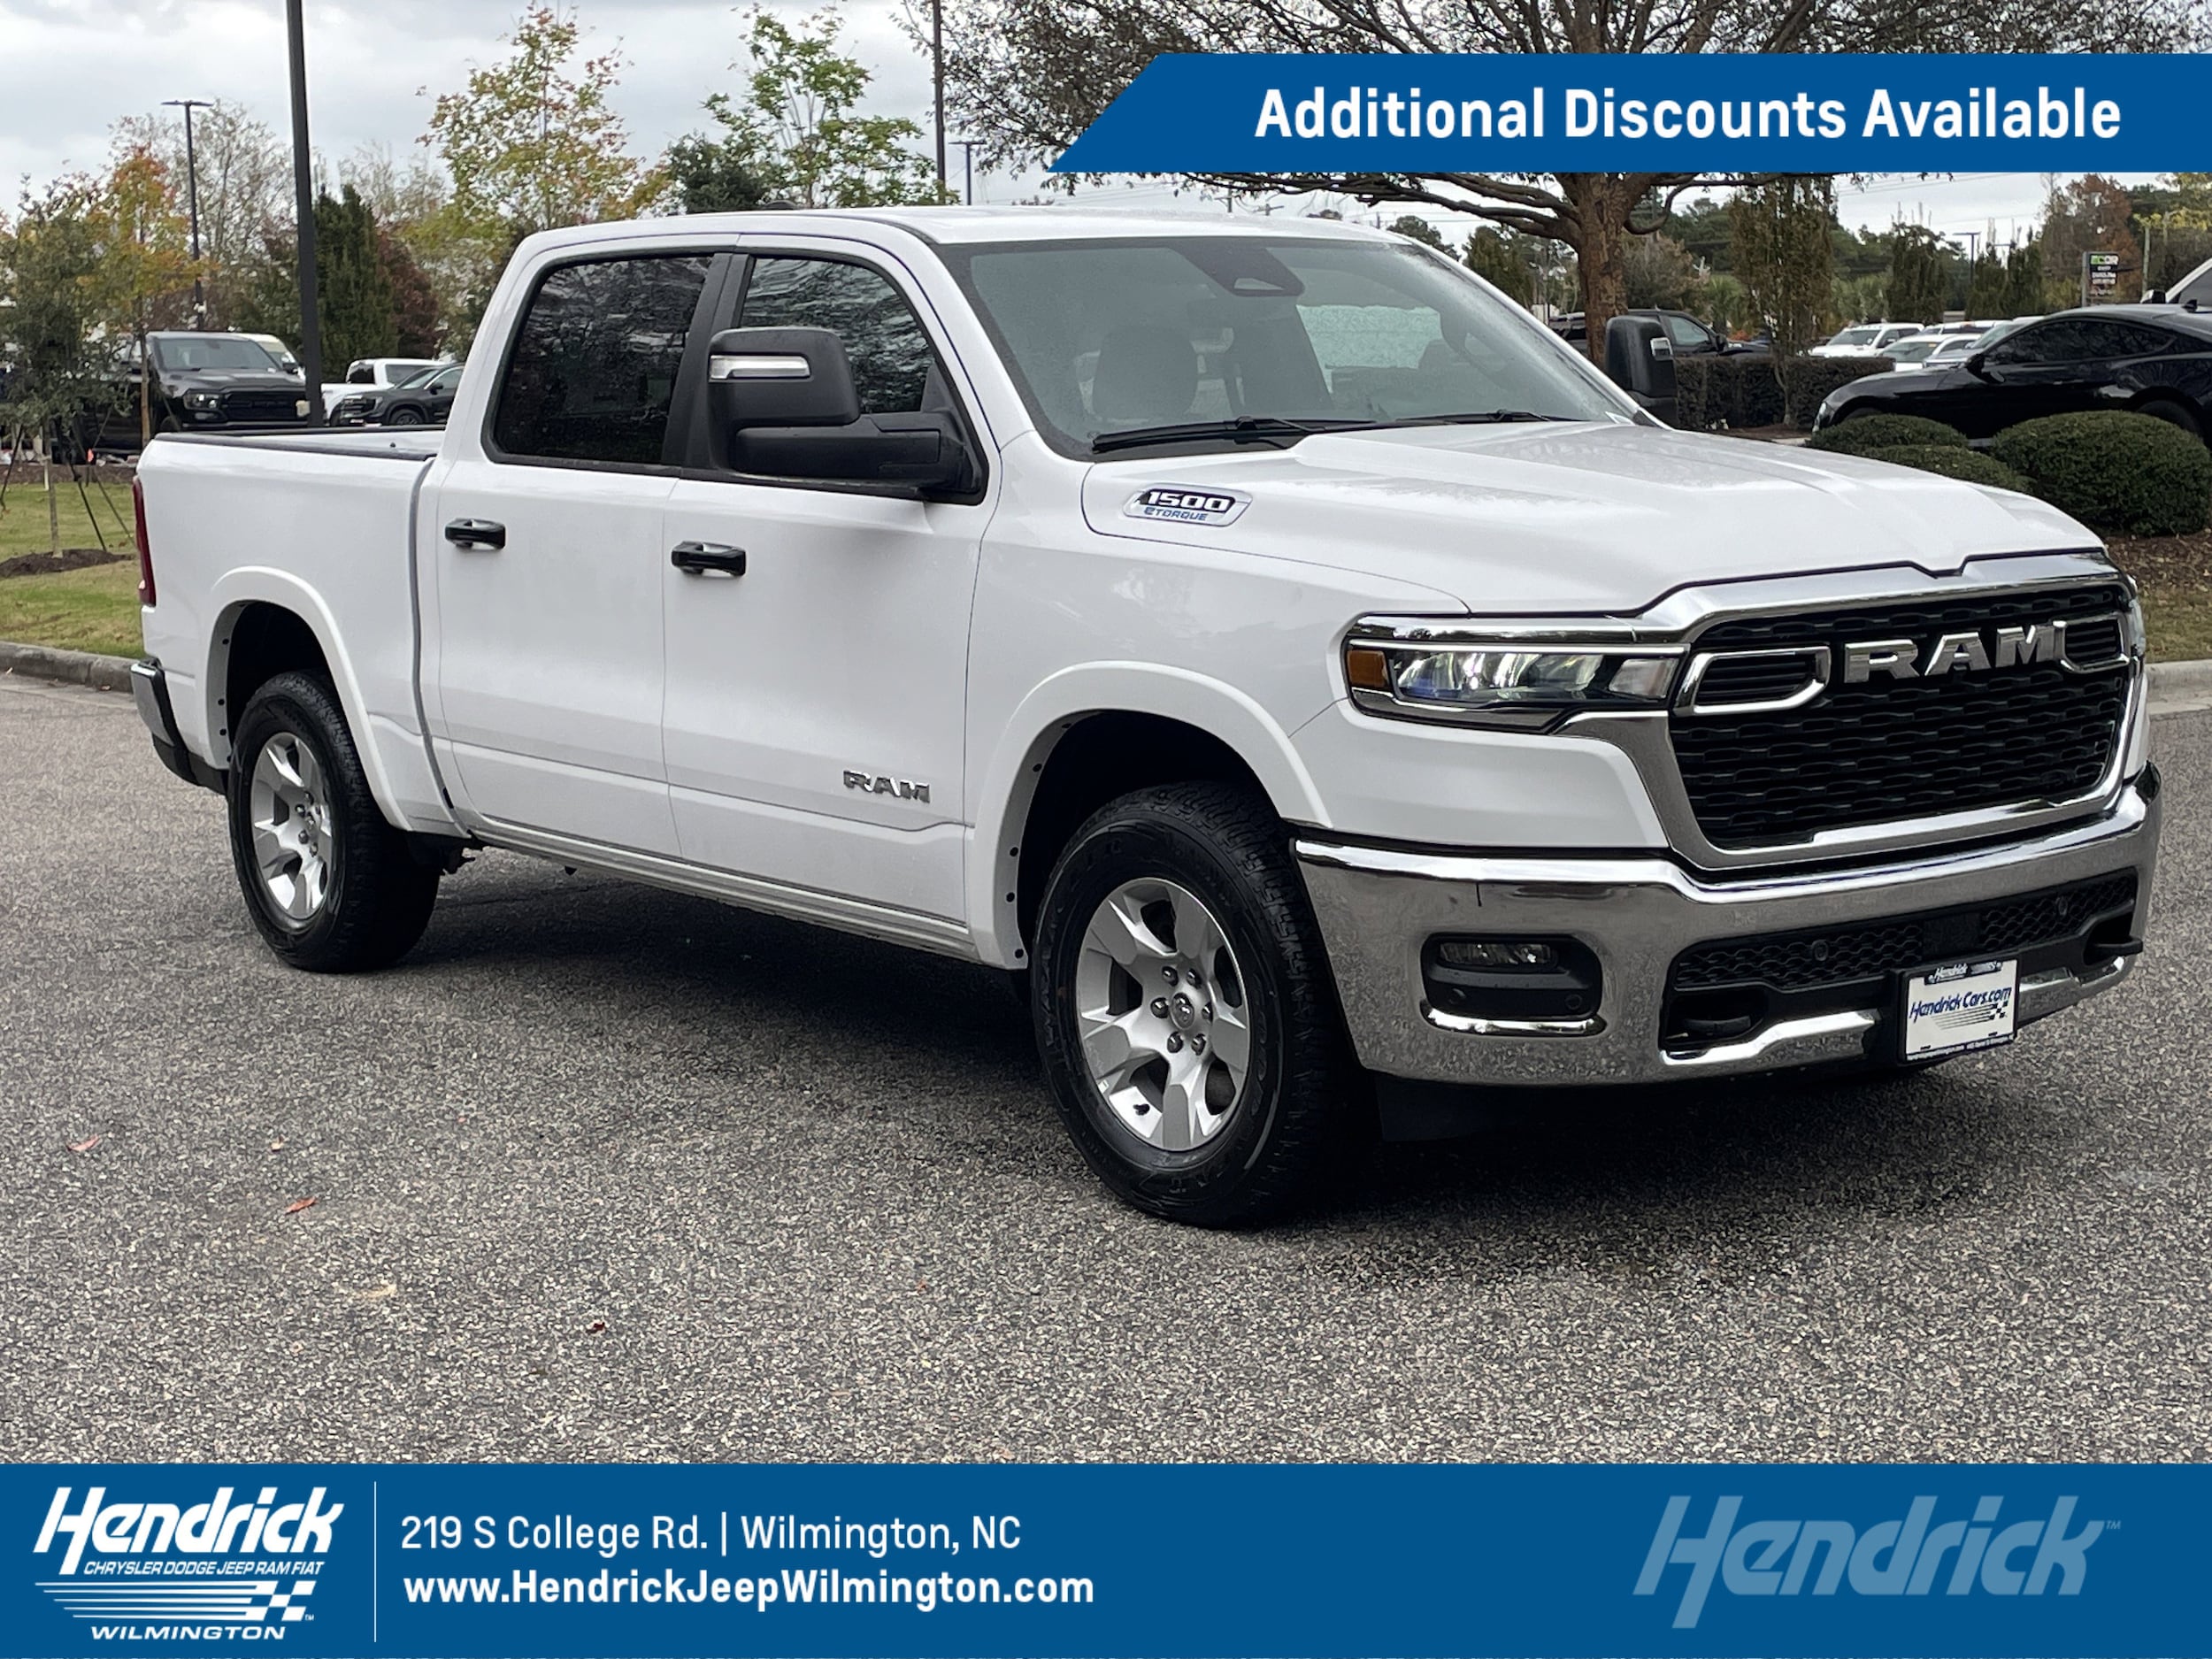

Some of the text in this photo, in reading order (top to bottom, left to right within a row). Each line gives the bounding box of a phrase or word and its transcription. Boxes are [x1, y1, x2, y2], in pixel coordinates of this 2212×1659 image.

[1148, 490, 1231, 511] 1500
[1844, 624, 2057, 684] RAM
[842, 770, 931, 803] RAM
